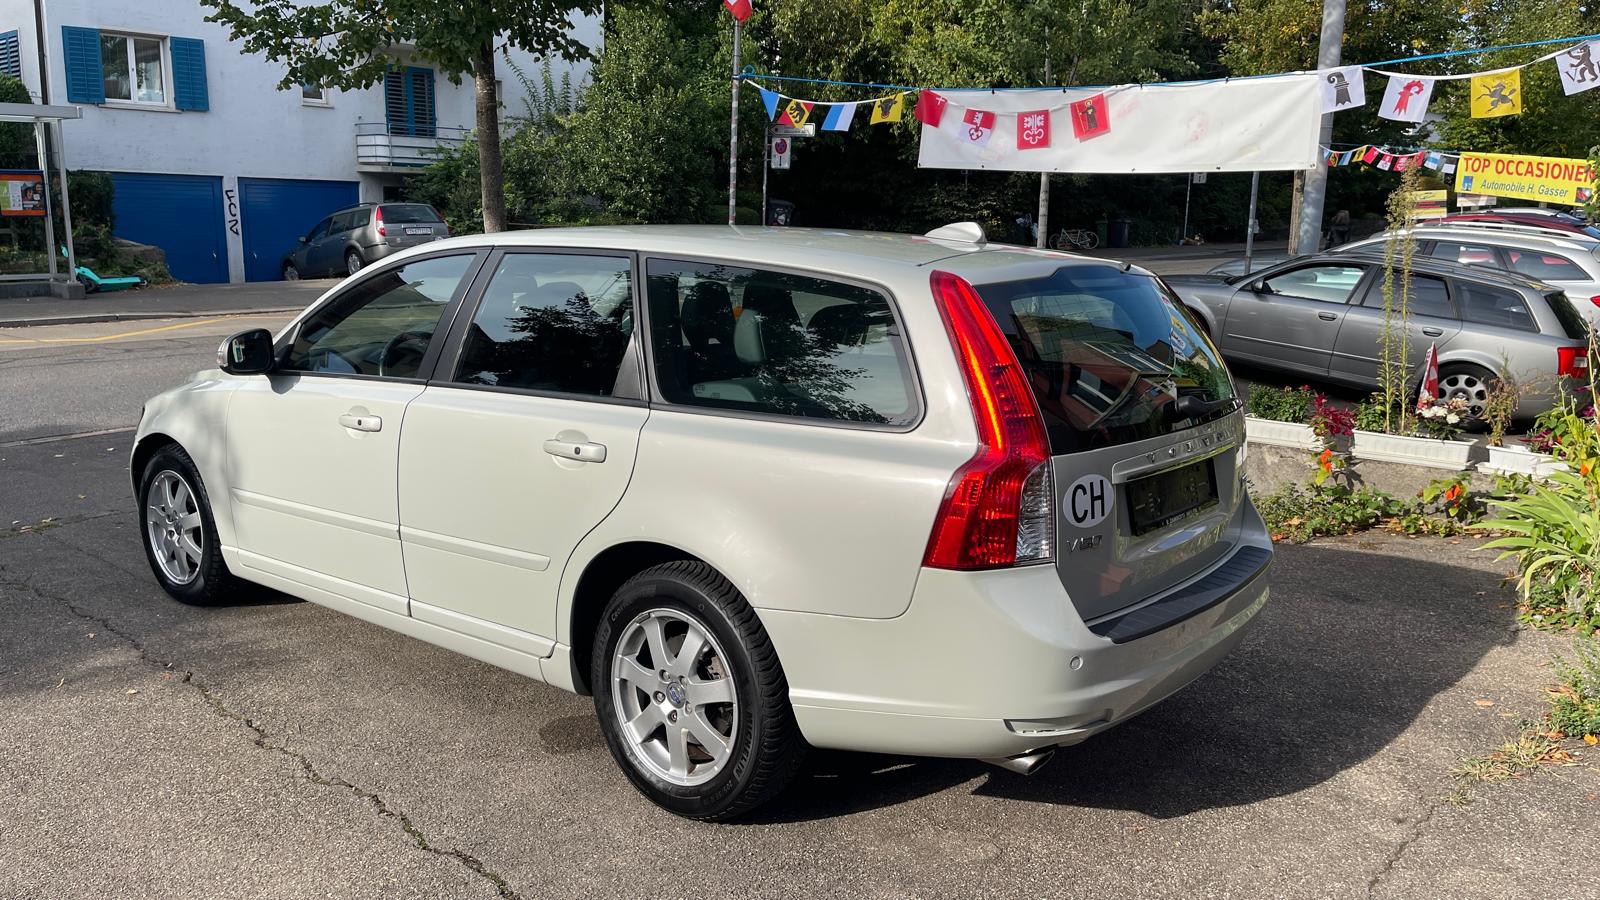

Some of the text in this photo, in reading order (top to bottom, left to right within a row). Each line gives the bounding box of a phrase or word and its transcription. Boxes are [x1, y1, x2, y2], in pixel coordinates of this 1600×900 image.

[1463, 157, 1491, 173] TOP
[1481, 179, 1569, 198] Automobile H. Gasser
[1071, 480, 1105, 524] CH
[735, 711, 753, 779] MICHELIN
